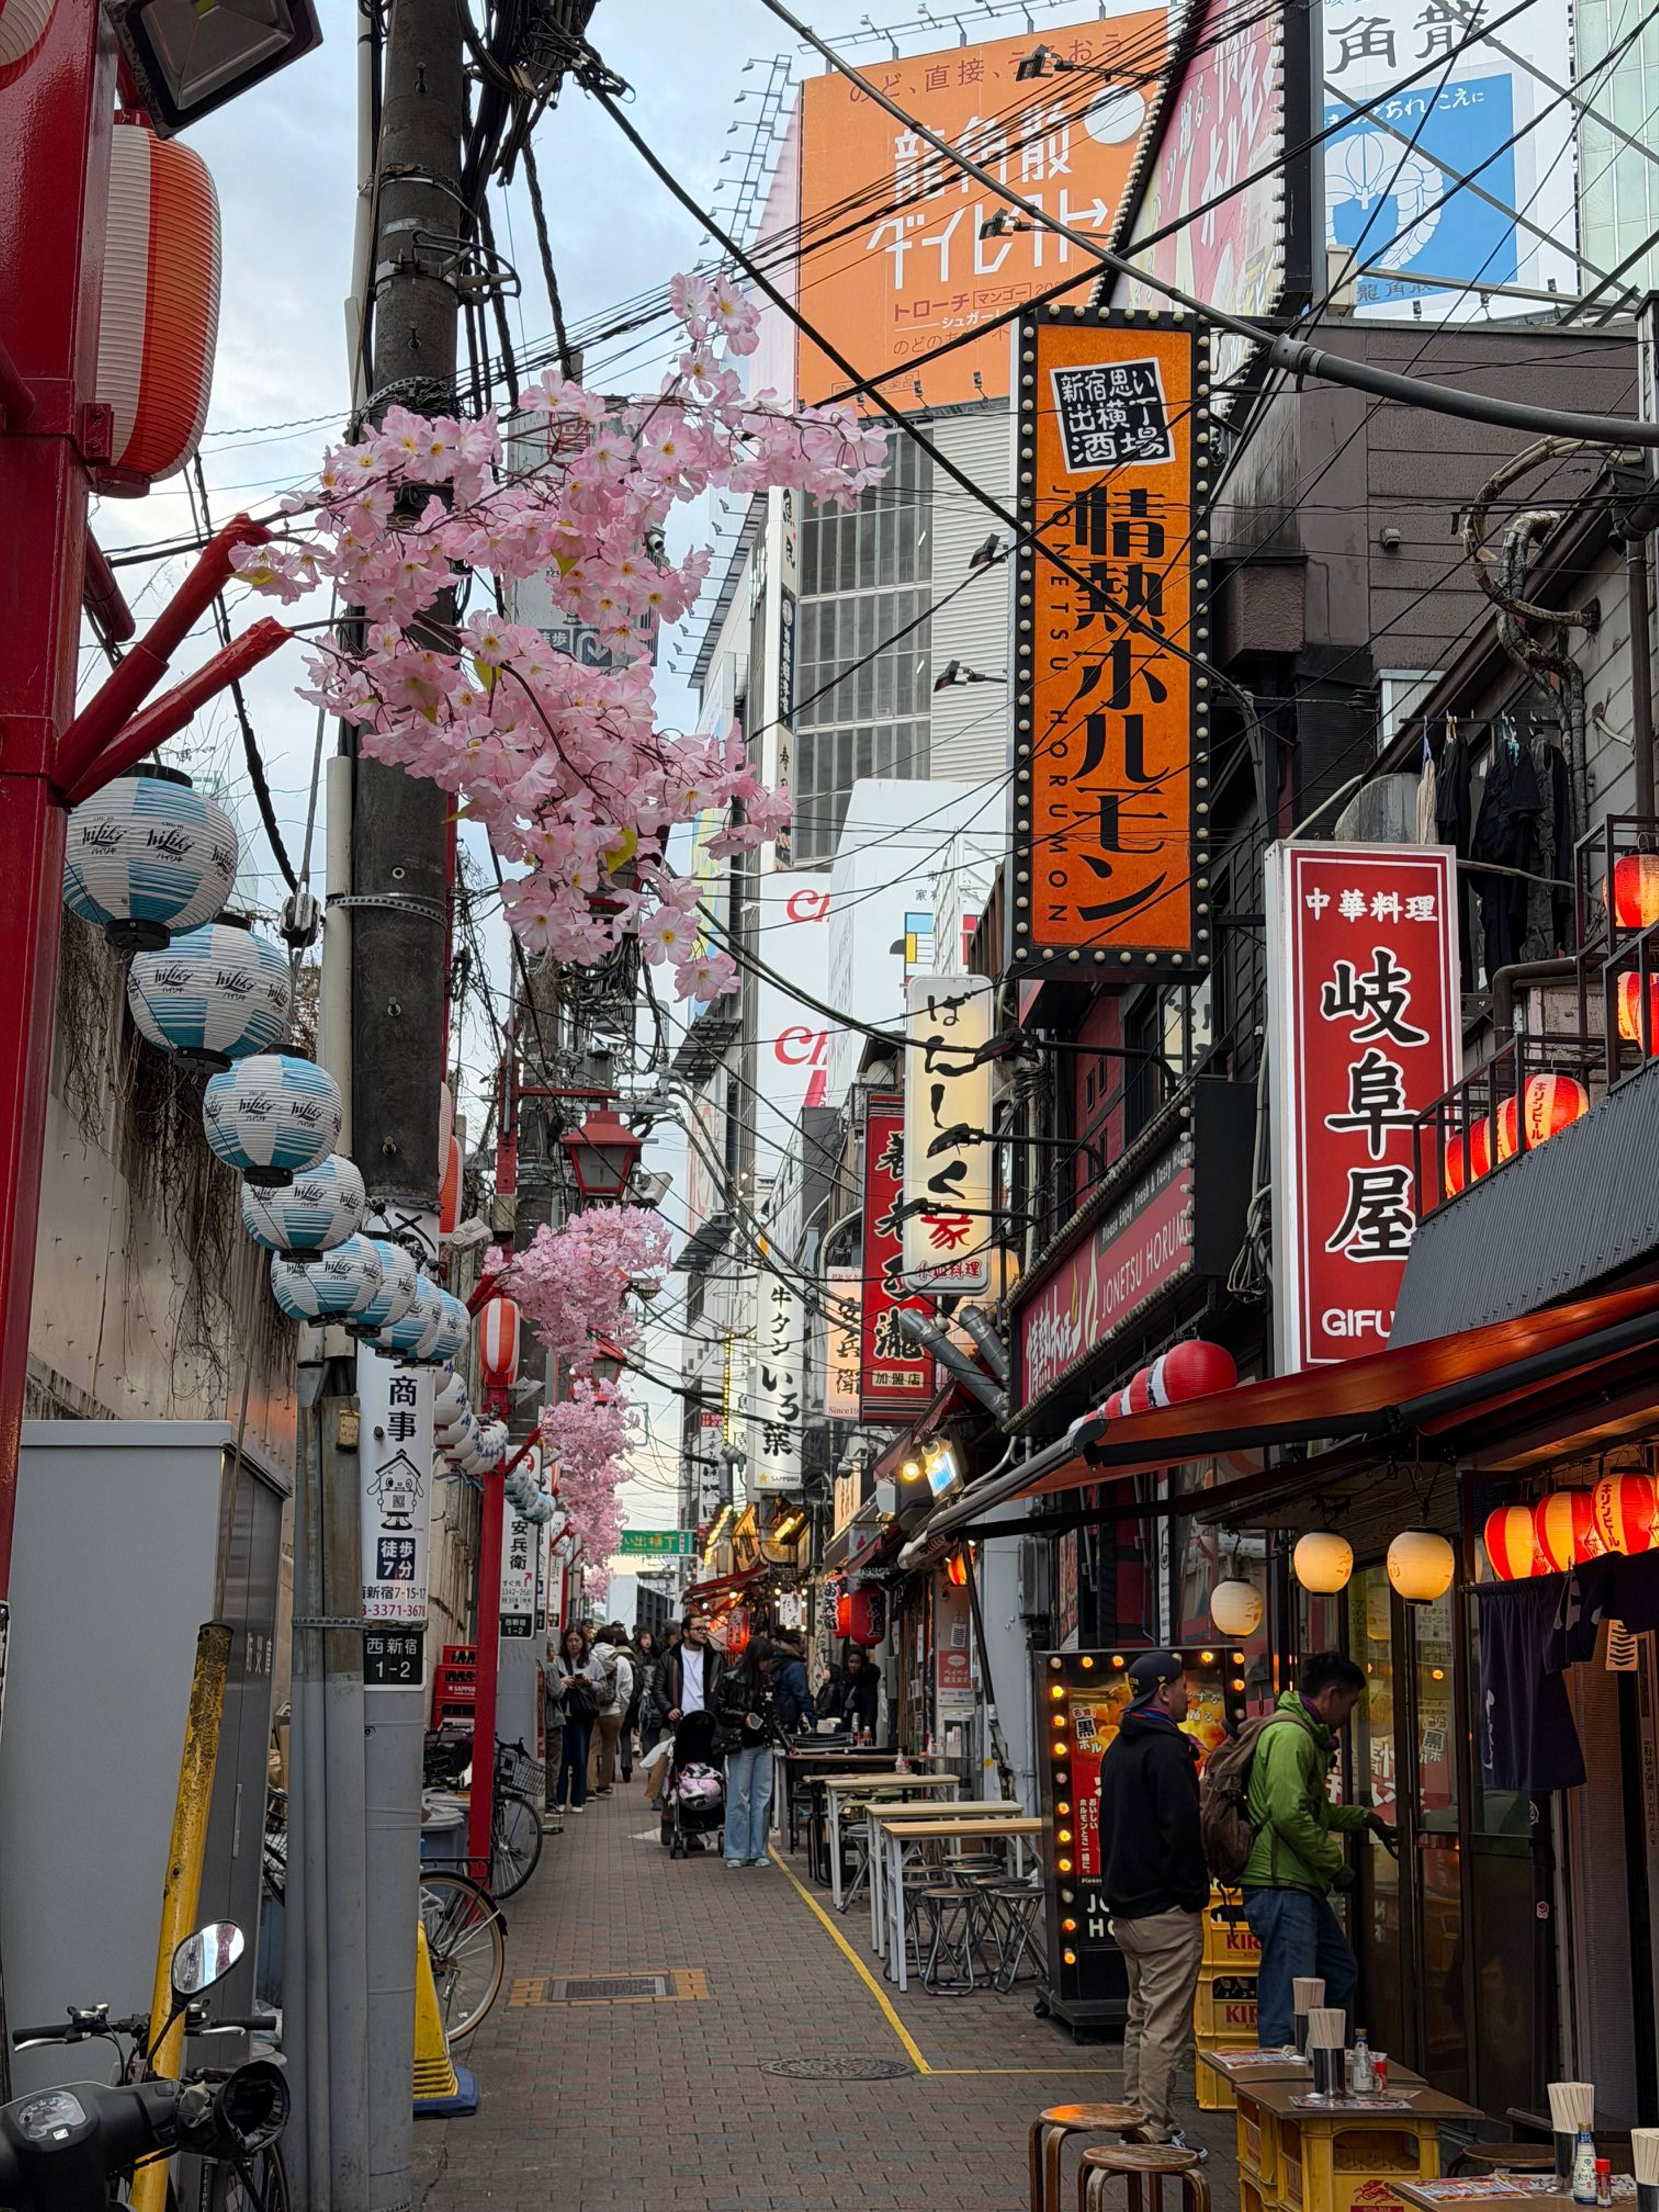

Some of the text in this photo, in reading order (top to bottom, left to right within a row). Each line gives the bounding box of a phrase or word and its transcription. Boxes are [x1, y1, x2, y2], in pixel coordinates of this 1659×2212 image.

[894, 99, 1074, 207] 龍角散
[894, 292, 970, 322] トローチ
[977, 287, 1029, 305] マンゴー
[1061, 368, 1154, 403] 新宿思い
[1069, 396, 1157, 431] 出横丁
[1071, 427, 1165, 463] 酒場
[1048, 709, 1068, 922] HORUMON
[1305, 887, 1438, 924] 中華料理
[920, 993, 977, 1251] ばんしく家
[1320, 946, 1430, 1263] 岐阜屋
[1531, 1082, 1547, 1140] キリンビール
[1102, 1248, 1143, 1319] JONETSU
[770, 1285, 792, 1356] 牛タン
[876, 1372, 921, 1386] 加盟店
[387, 1375, 418, 1442] 商事
[1601, 1483, 1620, 1548] キリンビール
[381, 1540, 413, 1558] 徒歩
[510, 1519, 529, 1570] 安兵衛
[383, 1560, 413, 1578] 7分
[367, 1637, 417, 1655] 西新宿
[375, 1661, 411, 1678] 1-2
[1089, 1798, 1098, 1830] おいしい
